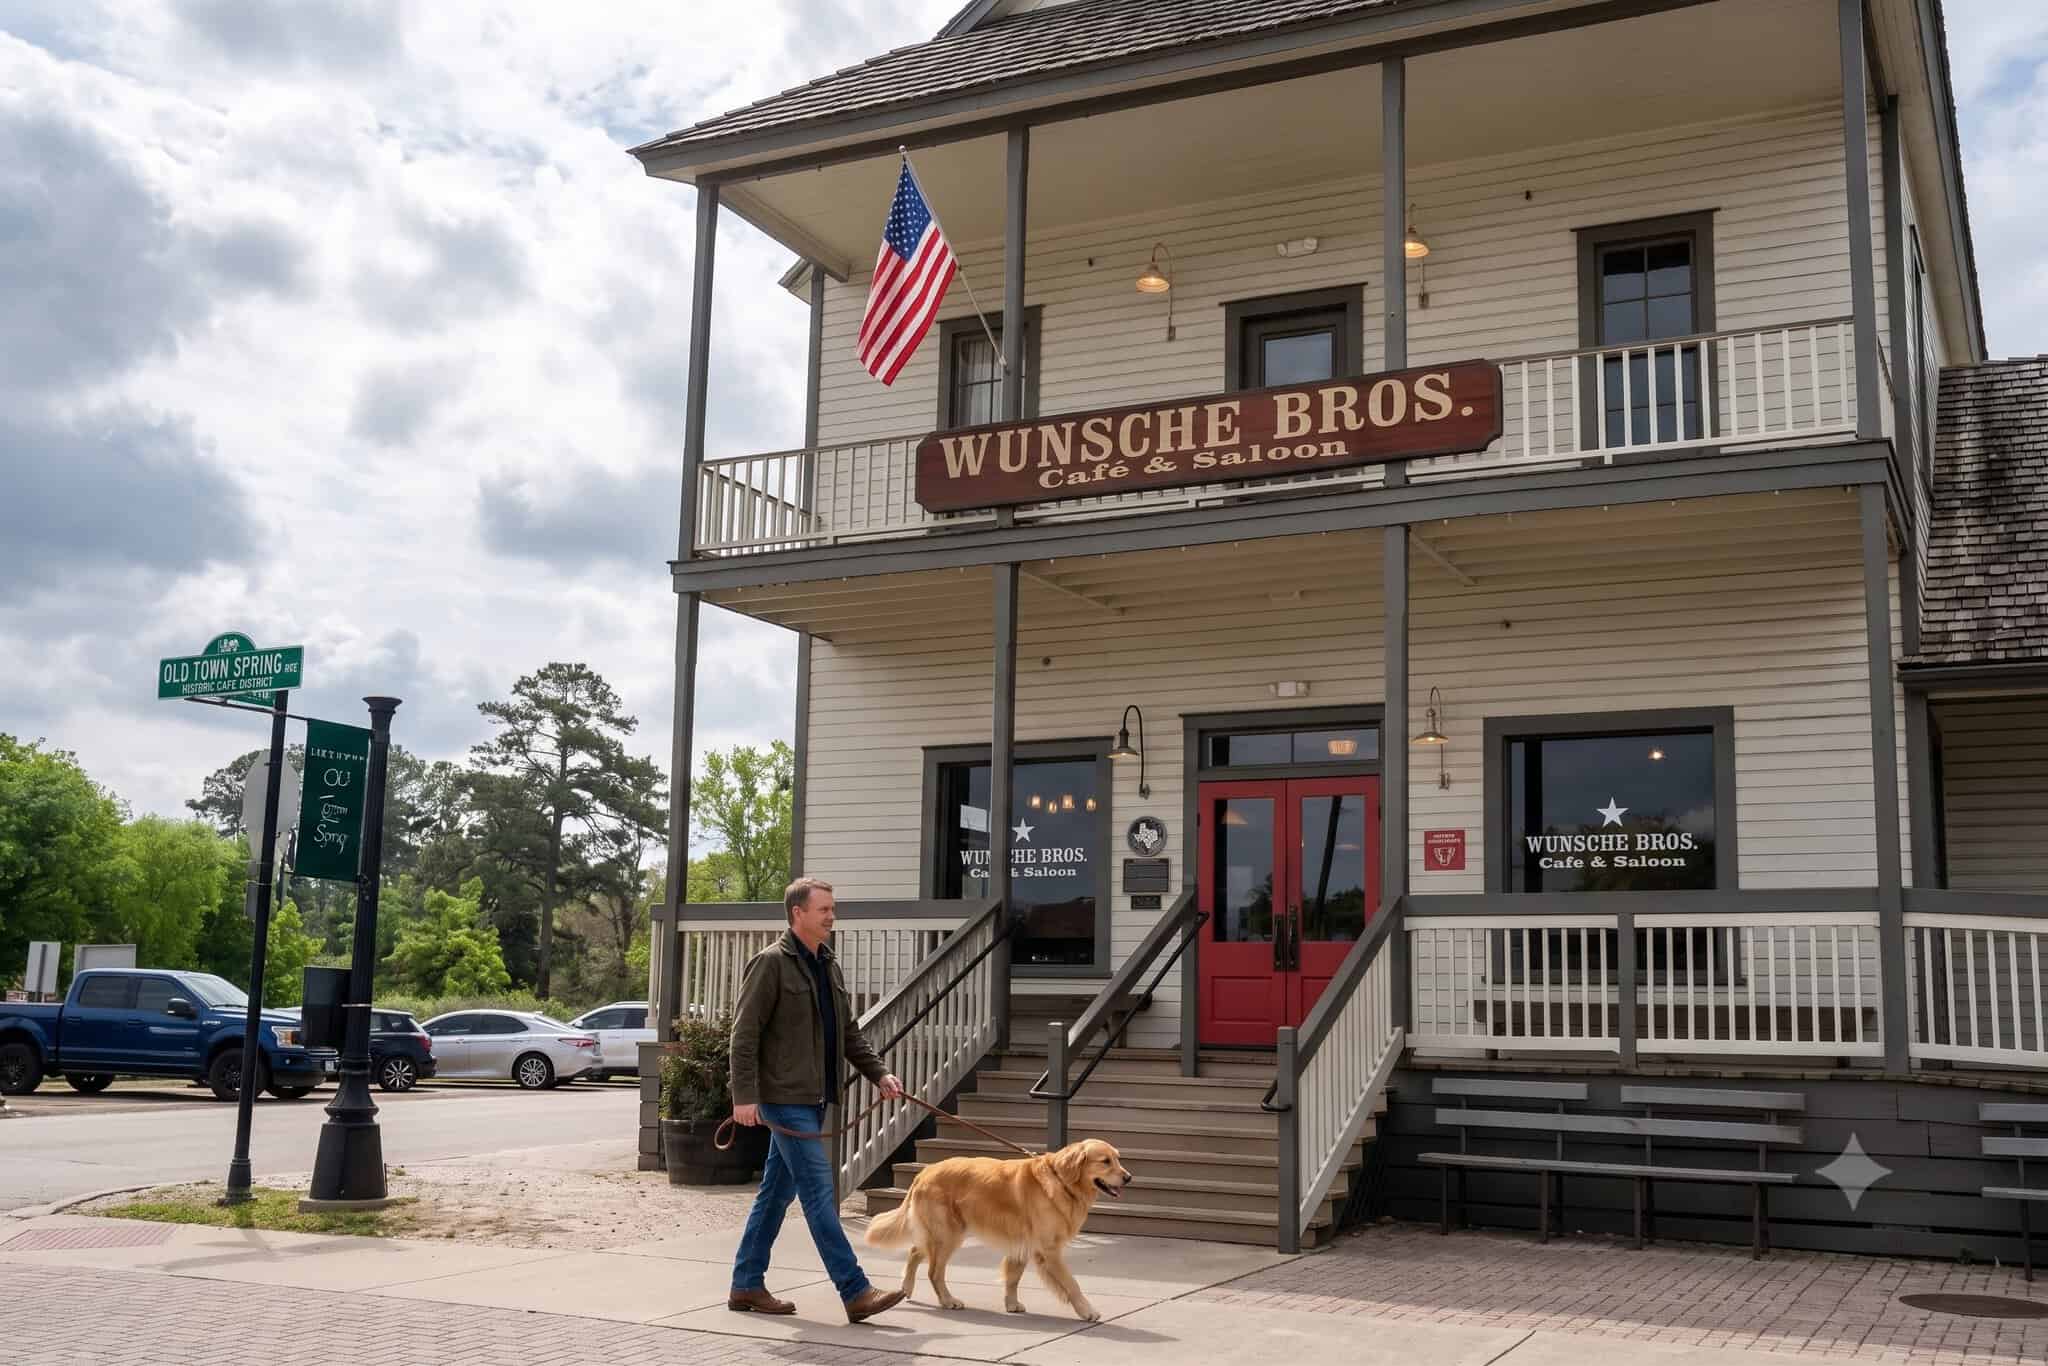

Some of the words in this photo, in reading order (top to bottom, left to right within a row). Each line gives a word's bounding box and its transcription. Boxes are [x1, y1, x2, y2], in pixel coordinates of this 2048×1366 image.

[940, 401, 1240, 479] WUNSCHE
[1271, 371, 1474, 441] BROS.
[1038, 462, 1129, 489] Café
[1144, 456, 1176, 474] &
[1191, 440, 1349, 470] Saloon
[164, 662, 189, 683] OLD
[193, 658, 229, 680] TOWN
[233, 653, 282, 677] SPRING
[216, 680, 237, 690] CAFE
[239, 677, 274, 688] DISTRICT
[1526, 834, 1629, 853] WUNSCHE
[1635, 833, 1698, 851] BROS.
[1041, 848, 1087, 863] BROS.
[1539, 857, 1584, 869] Cafe
[1591, 856, 1607, 868] &
[1613, 855, 1686, 868] Saloon
[1024, 867, 1077, 877] Saloon
